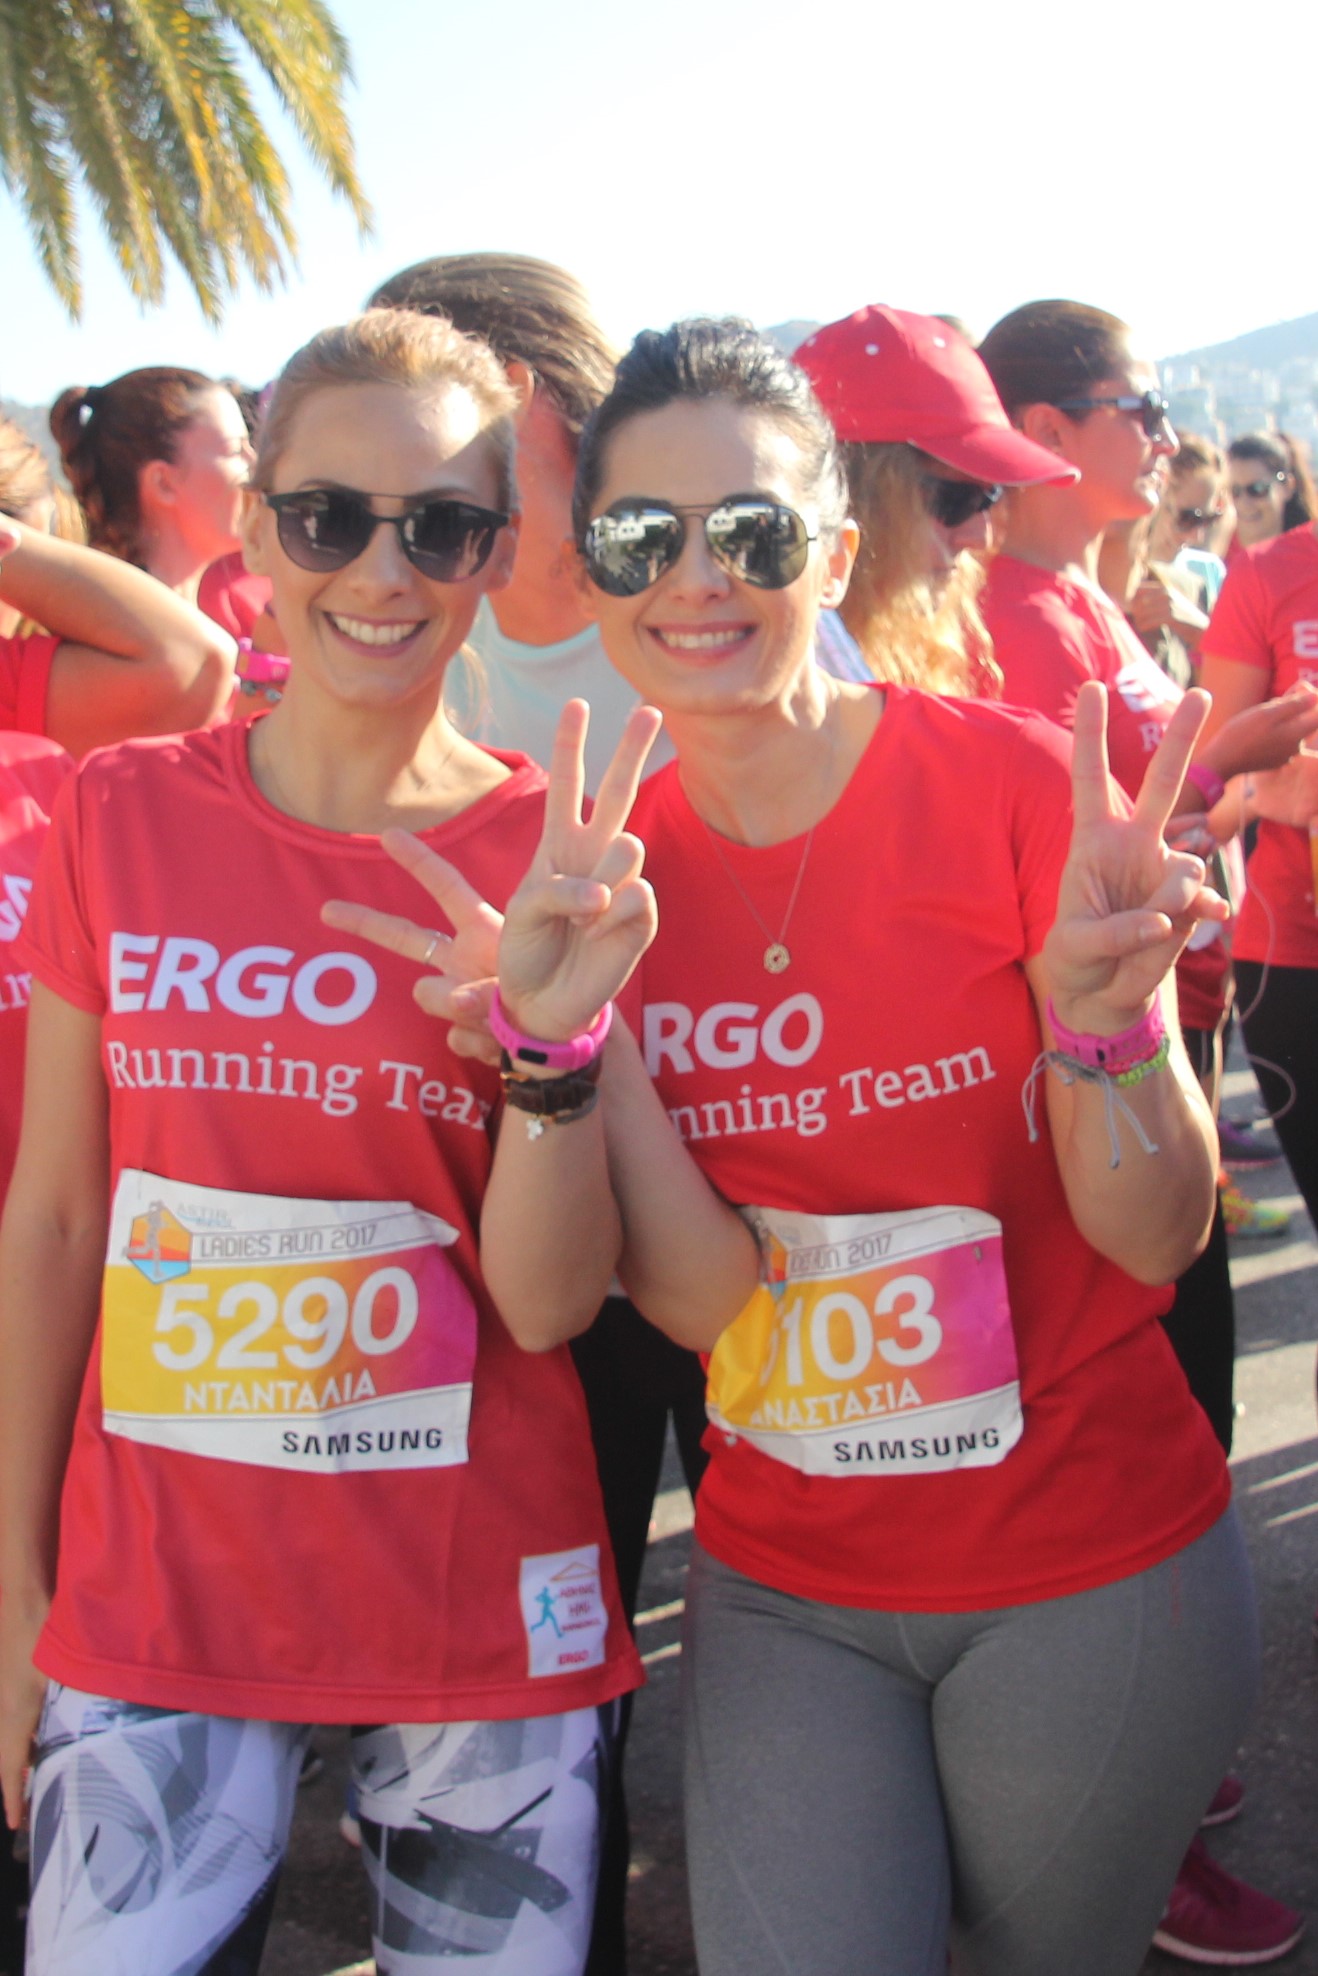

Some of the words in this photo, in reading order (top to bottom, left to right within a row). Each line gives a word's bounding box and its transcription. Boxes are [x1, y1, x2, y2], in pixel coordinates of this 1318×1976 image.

[110, 931, 377, 1026] ERGO
[642, 992, 824, 1078] RGO
[106, 1040, 363, 1118] Running
[378, 1060, 491, 1131] Tea
[668, 1083, 828, 1137] nning
[839, 1045, 997, 1117] Team
[200, 1234, 271, 1259] LADIES
[278, 1231, 322, 1255] RUN
[331, 1224, 378, 1250] 2017
[847, 1232, 892, 1265] 2017
[151, 1266, 419, 1372] 5290
[183, 1368, 377, 1413] ΝΤΑΝΤΑΛΙΑ
[282, 1428, 443, 1456] SAMSUNG
[833, 1427, 1000, 1463] SAMSUNG
